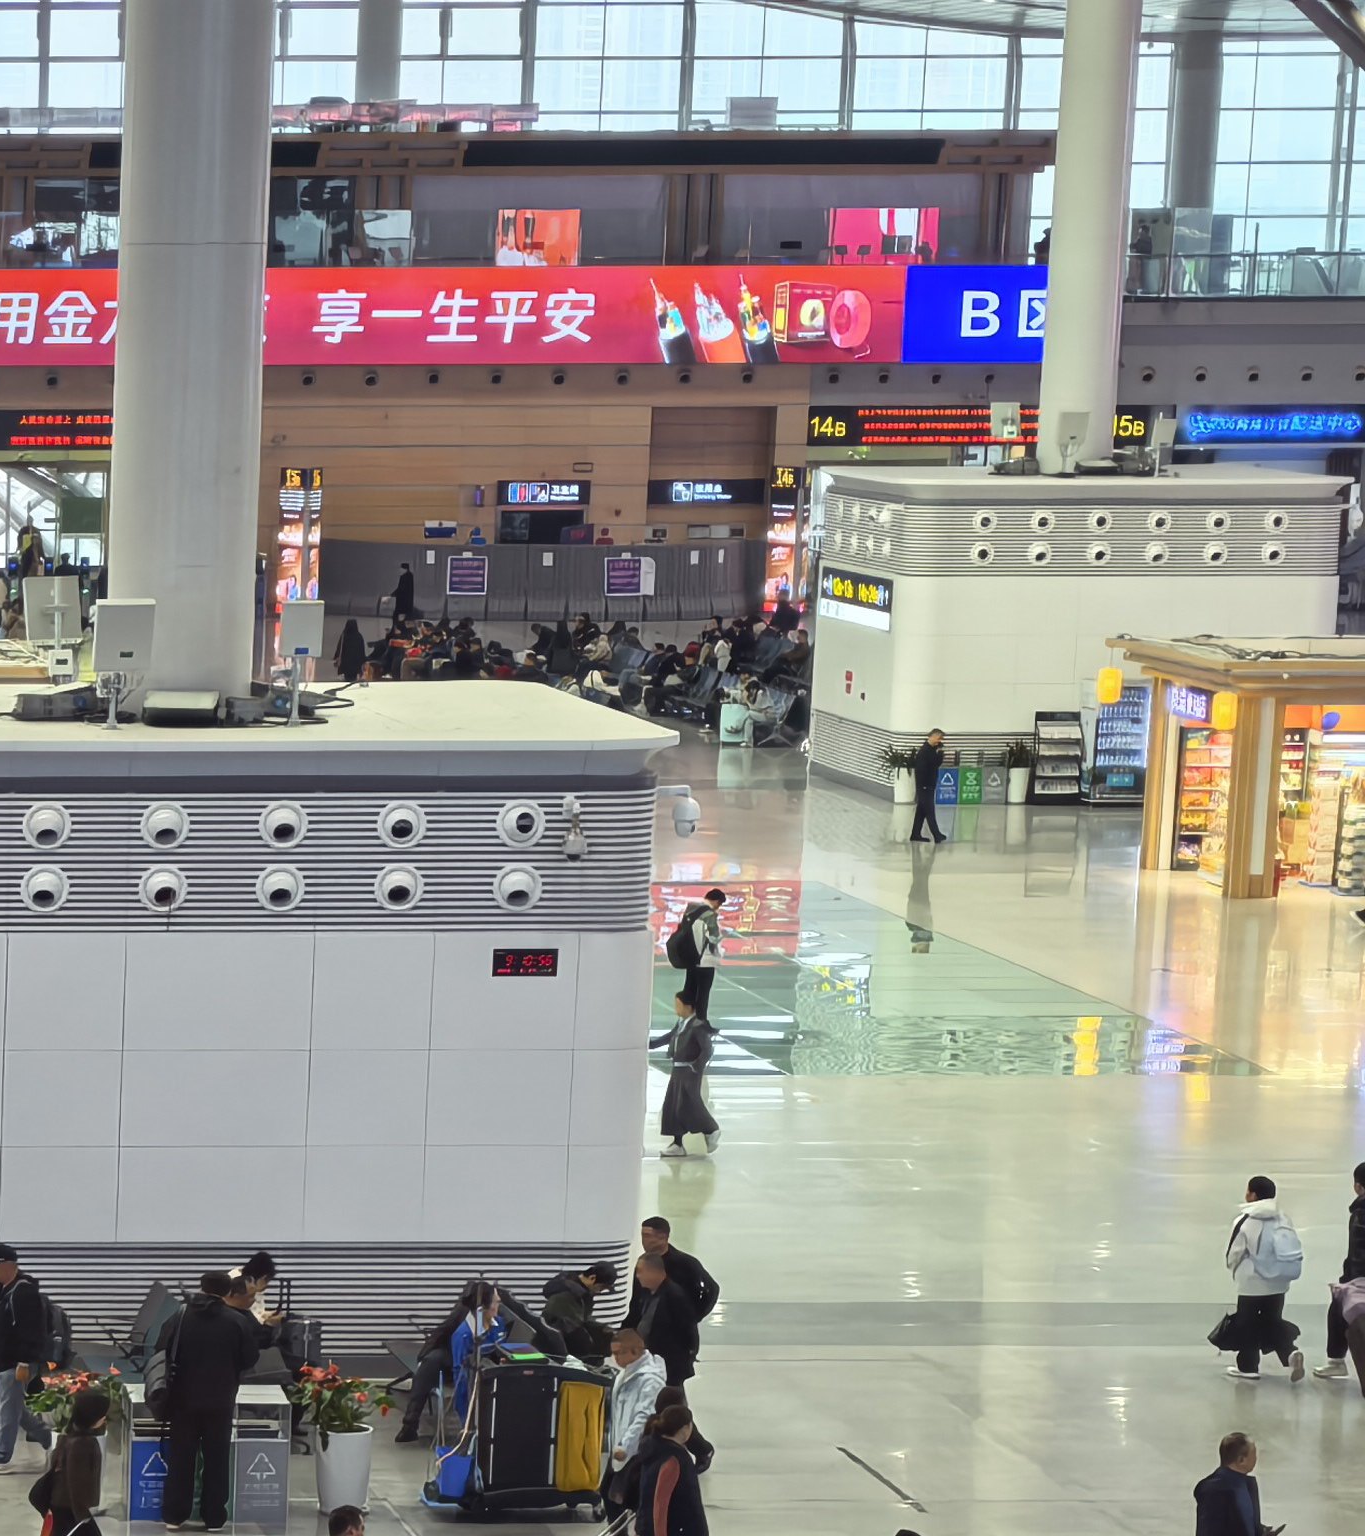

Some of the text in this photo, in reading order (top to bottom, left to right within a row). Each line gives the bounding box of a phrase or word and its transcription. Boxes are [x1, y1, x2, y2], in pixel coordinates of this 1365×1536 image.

[312, 288, 597, 344] 享一生平安
[810, 416, 847, 437] 14B
